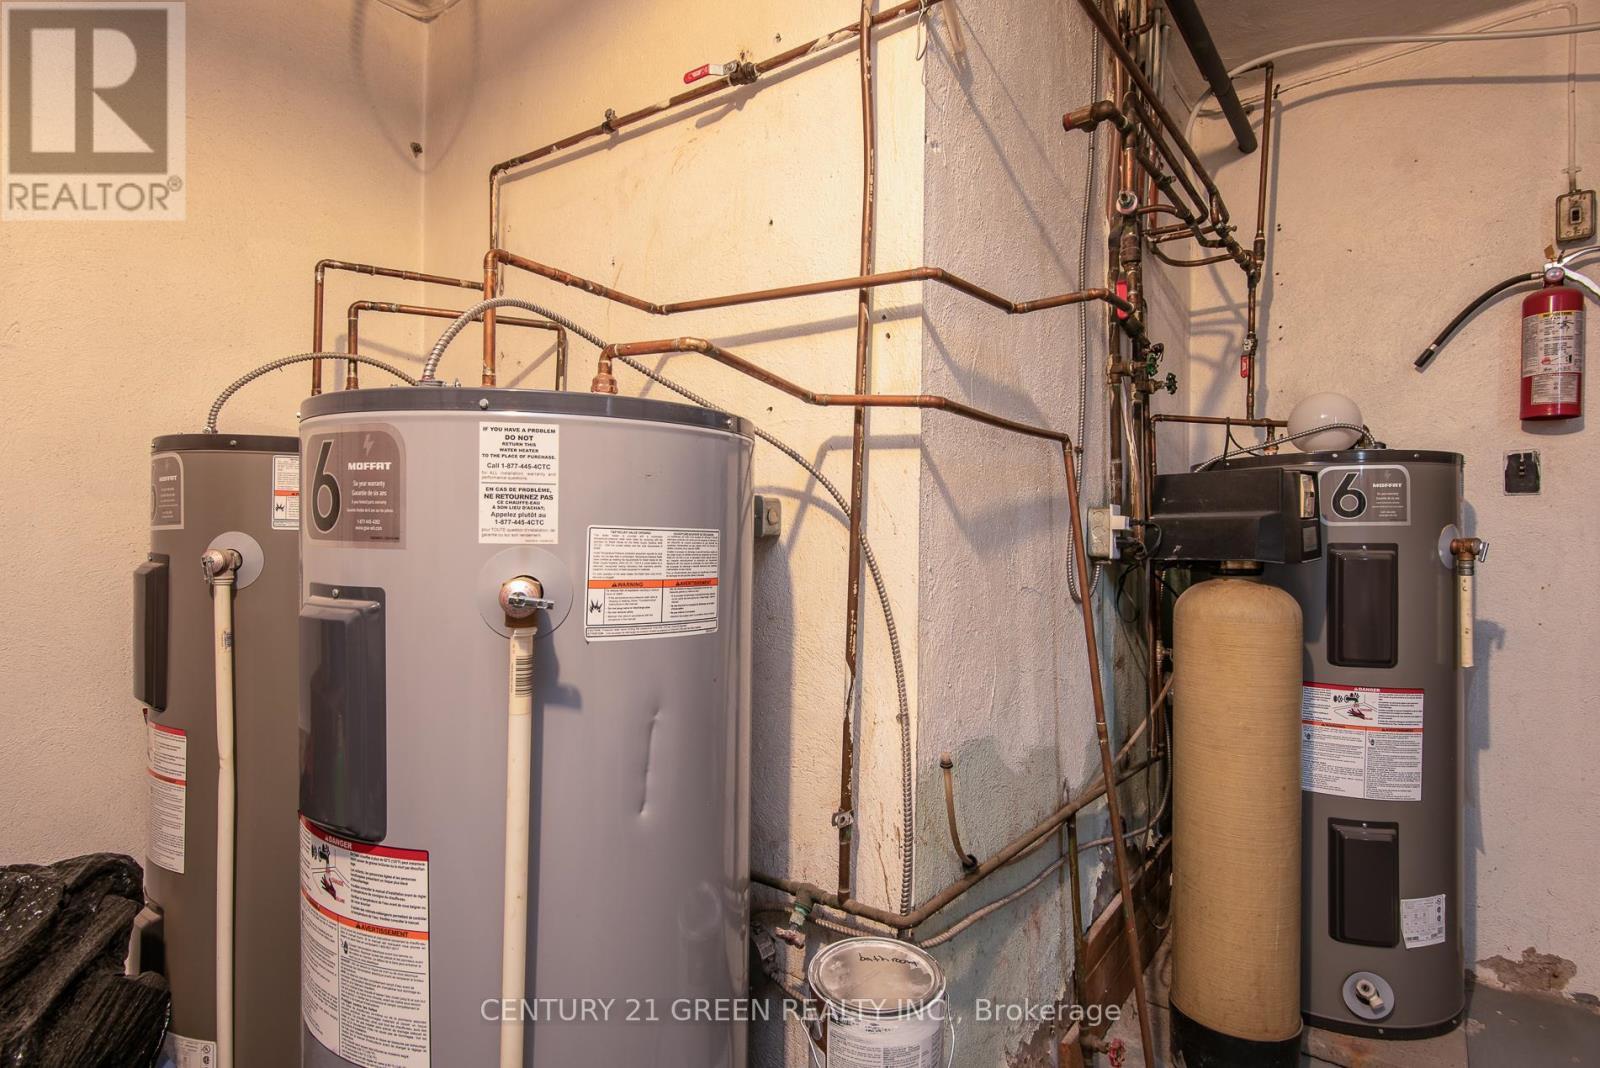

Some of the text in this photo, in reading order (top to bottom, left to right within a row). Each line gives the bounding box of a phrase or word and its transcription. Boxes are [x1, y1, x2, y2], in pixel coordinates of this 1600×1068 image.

[348, 462, 392, 470] MOFFAT
[312, 439, 342, 534] 6
[1331, 472, 1367, 519] 6
[328, 836, 352, 850] DANGER
[361, 924, 408, 938] AVERTISSEMENT
